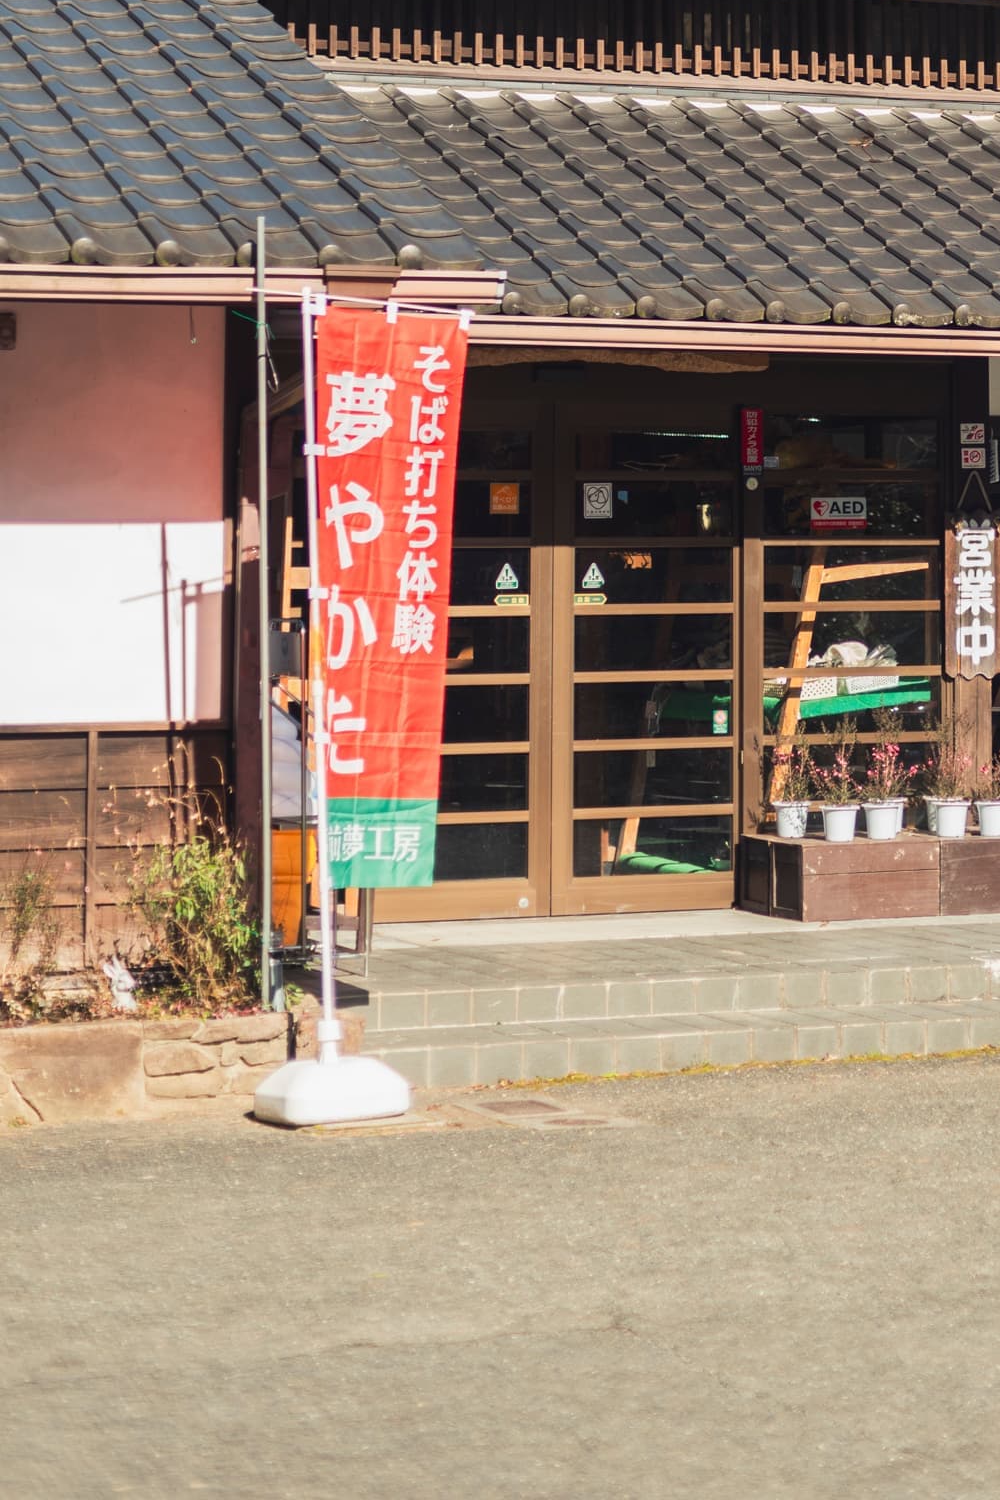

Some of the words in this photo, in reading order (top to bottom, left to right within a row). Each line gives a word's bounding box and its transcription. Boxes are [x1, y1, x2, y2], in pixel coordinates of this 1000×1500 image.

[325, 371, 396, 775] 夢やかた
[391, 345, 450, 654] そば打ち体験
[829, 501, 864, 514] AED
[953, 519, 996, 665] 営業中
